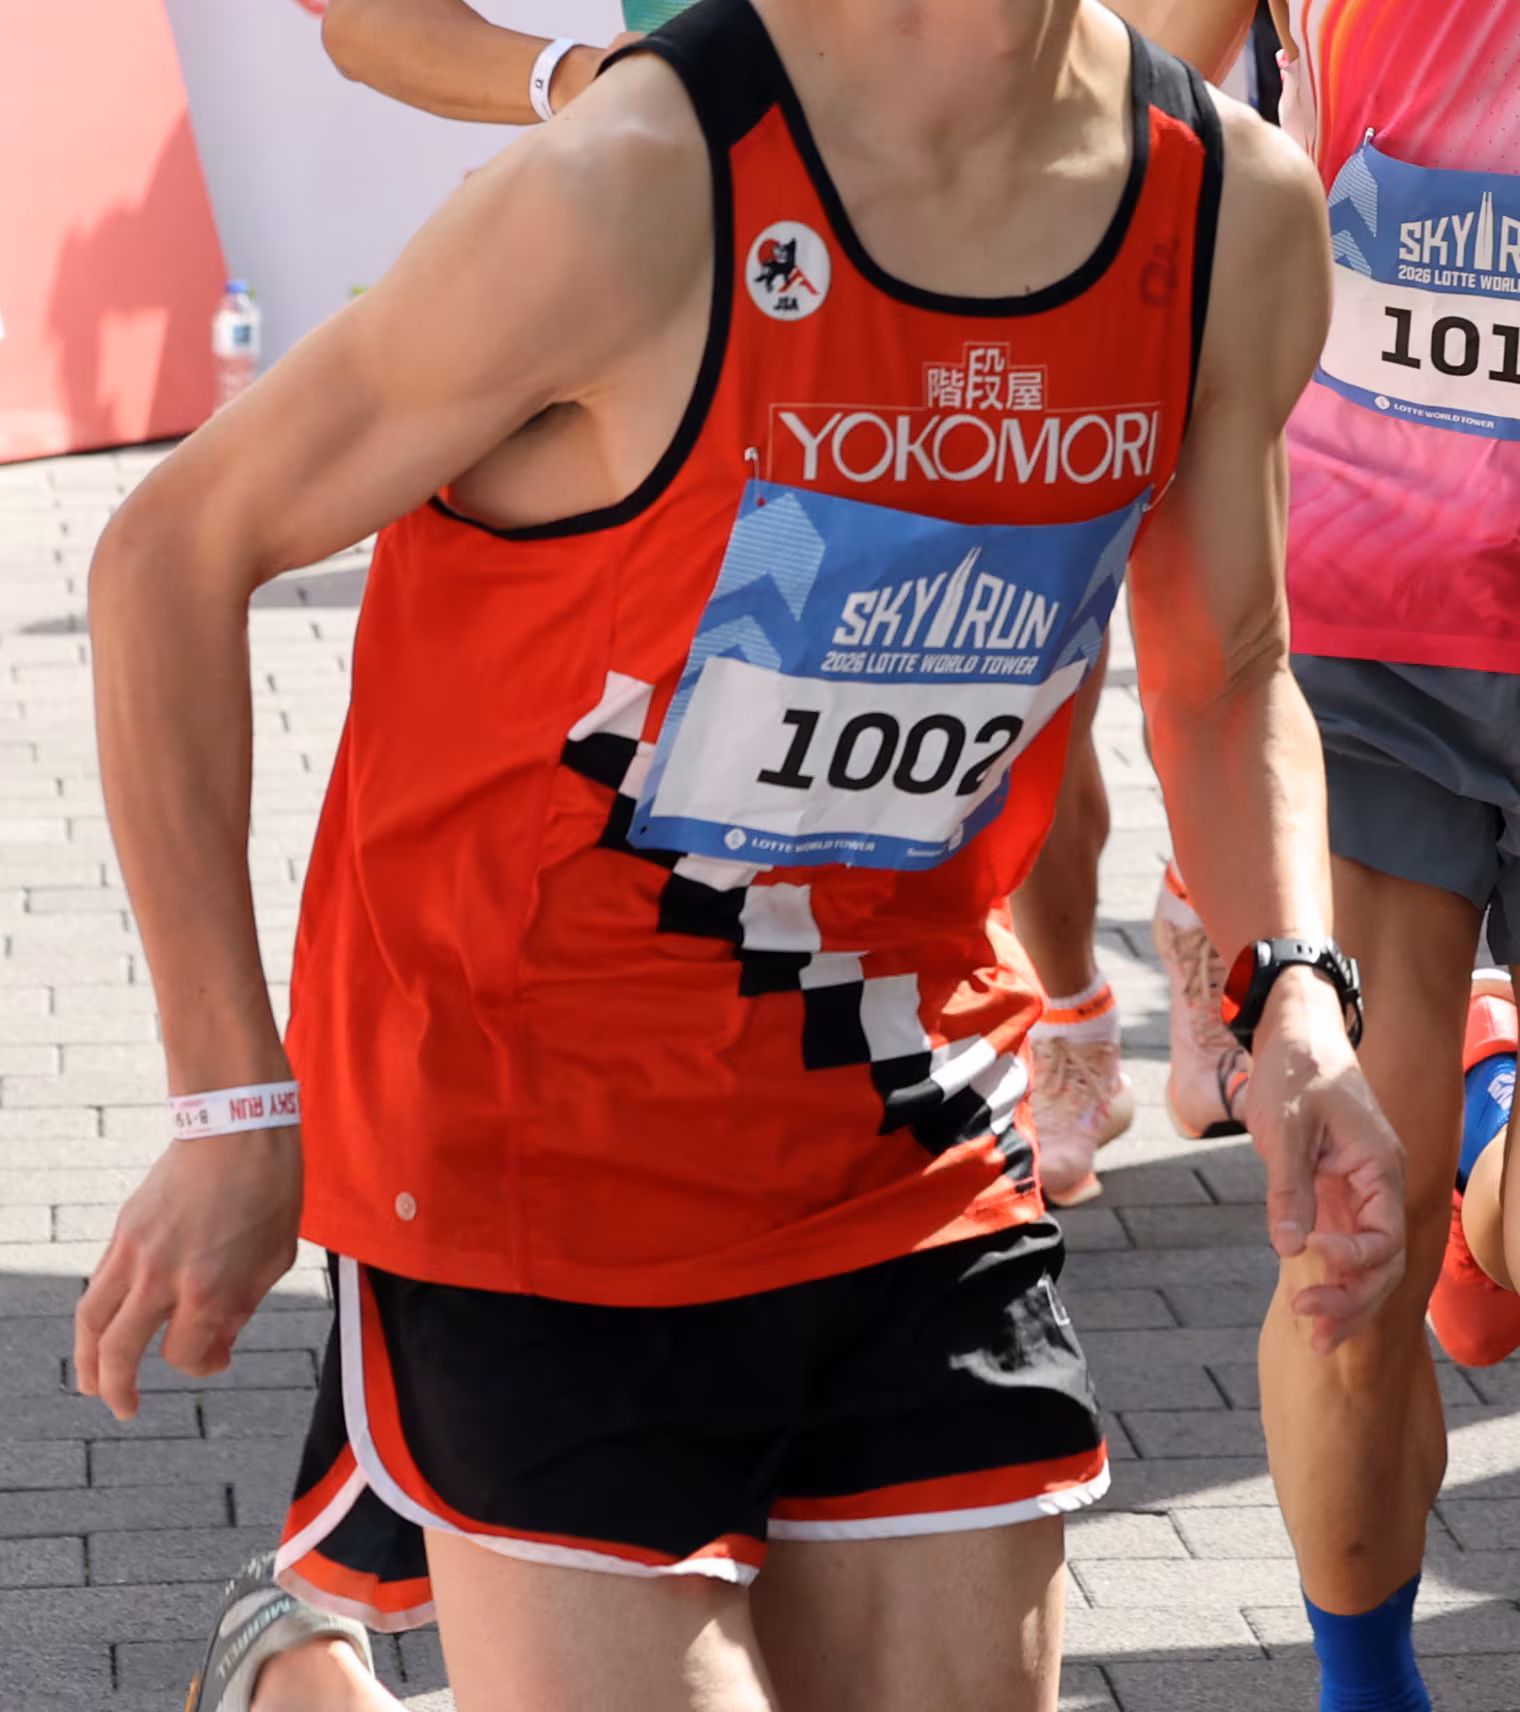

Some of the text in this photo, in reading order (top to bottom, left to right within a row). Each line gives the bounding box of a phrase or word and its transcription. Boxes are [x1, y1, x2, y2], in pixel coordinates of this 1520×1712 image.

[1398, 211, 1475, 268] SKY
[1398, 265, 1432, 284] 2026
[1434, 269, 1476, 288] LOTTE
[926, 347, 1043, 411] 階段屋
[1393, 403, 1495, 429] LOTTE WORLD TOWER
[779, 409, 1159, 485] YOKOMORI
[832, 571, 1061, 649] SKY RUN
[821, 650, 1040, 675] 2026 LOTTE WORLD TOWER
[757, 707, 1024, 797] 1002
[752, 837, 792, 853] LOTTE
[228, 1090, 298, 1124] SKY RUN
